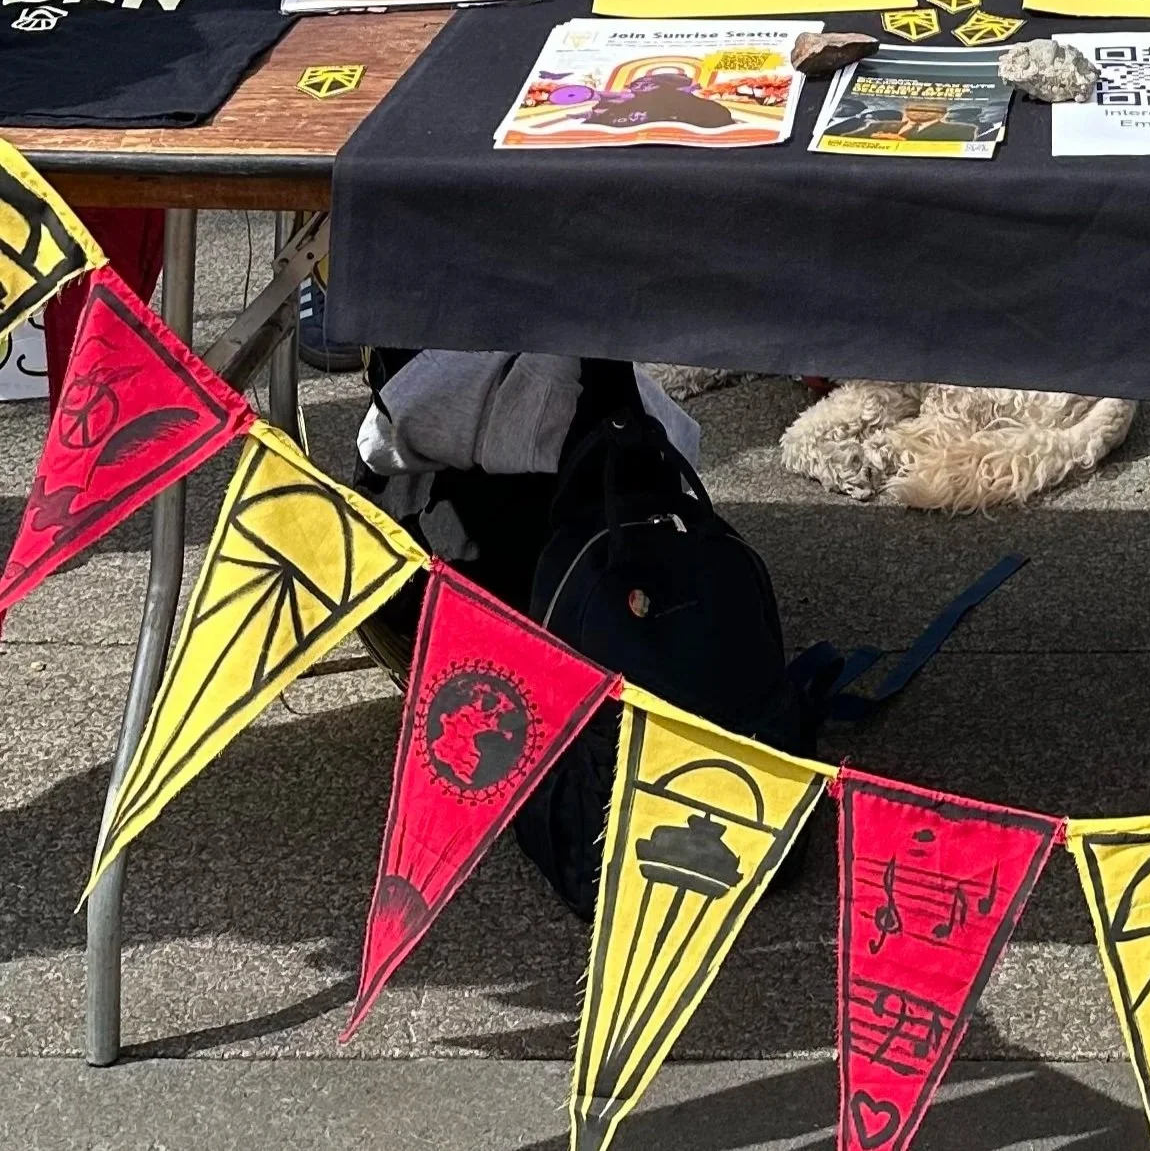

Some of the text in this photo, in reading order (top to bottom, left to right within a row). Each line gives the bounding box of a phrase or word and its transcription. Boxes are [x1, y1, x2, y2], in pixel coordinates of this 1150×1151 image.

[608, 30, 789, 40] Join Sunrise Seattle
